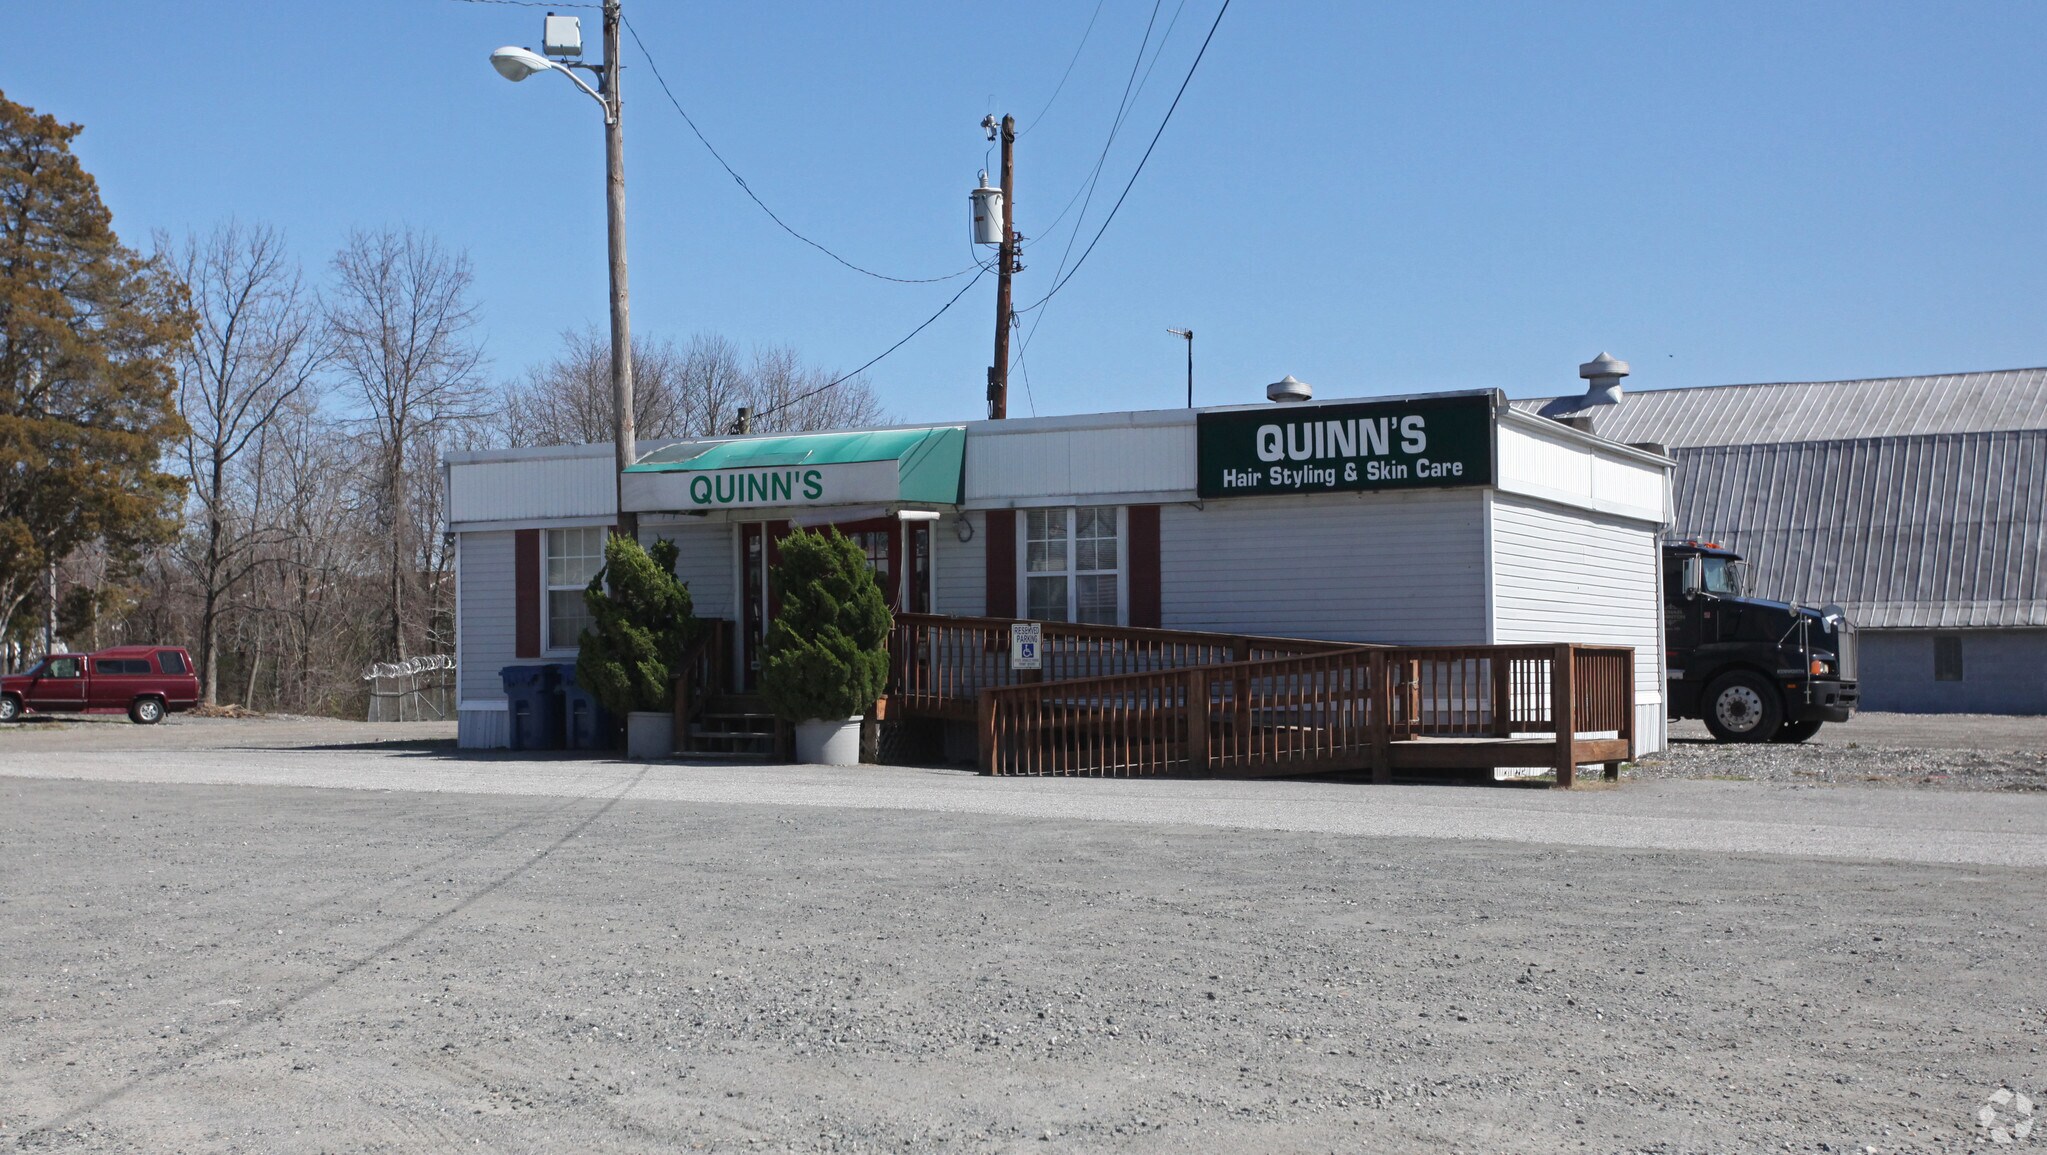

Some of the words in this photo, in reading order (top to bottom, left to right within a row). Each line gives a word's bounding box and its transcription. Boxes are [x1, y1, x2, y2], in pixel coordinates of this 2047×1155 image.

[1256, 415, 1427, 462] QUINN'S
[690, 470, 823, 505] QUINN'S
[1223, 469, 1261, 488] Hair
[1269, 466, 1336, 489] Styling
[1343, 462, 1358, 482] &
[1366, 460, 1408, 481] Skin
[1416, 458, 1463, 478] Care
[1014, 626, 1040, 634] RESERVED
[1016, 635, 1038, 643] PARKING
